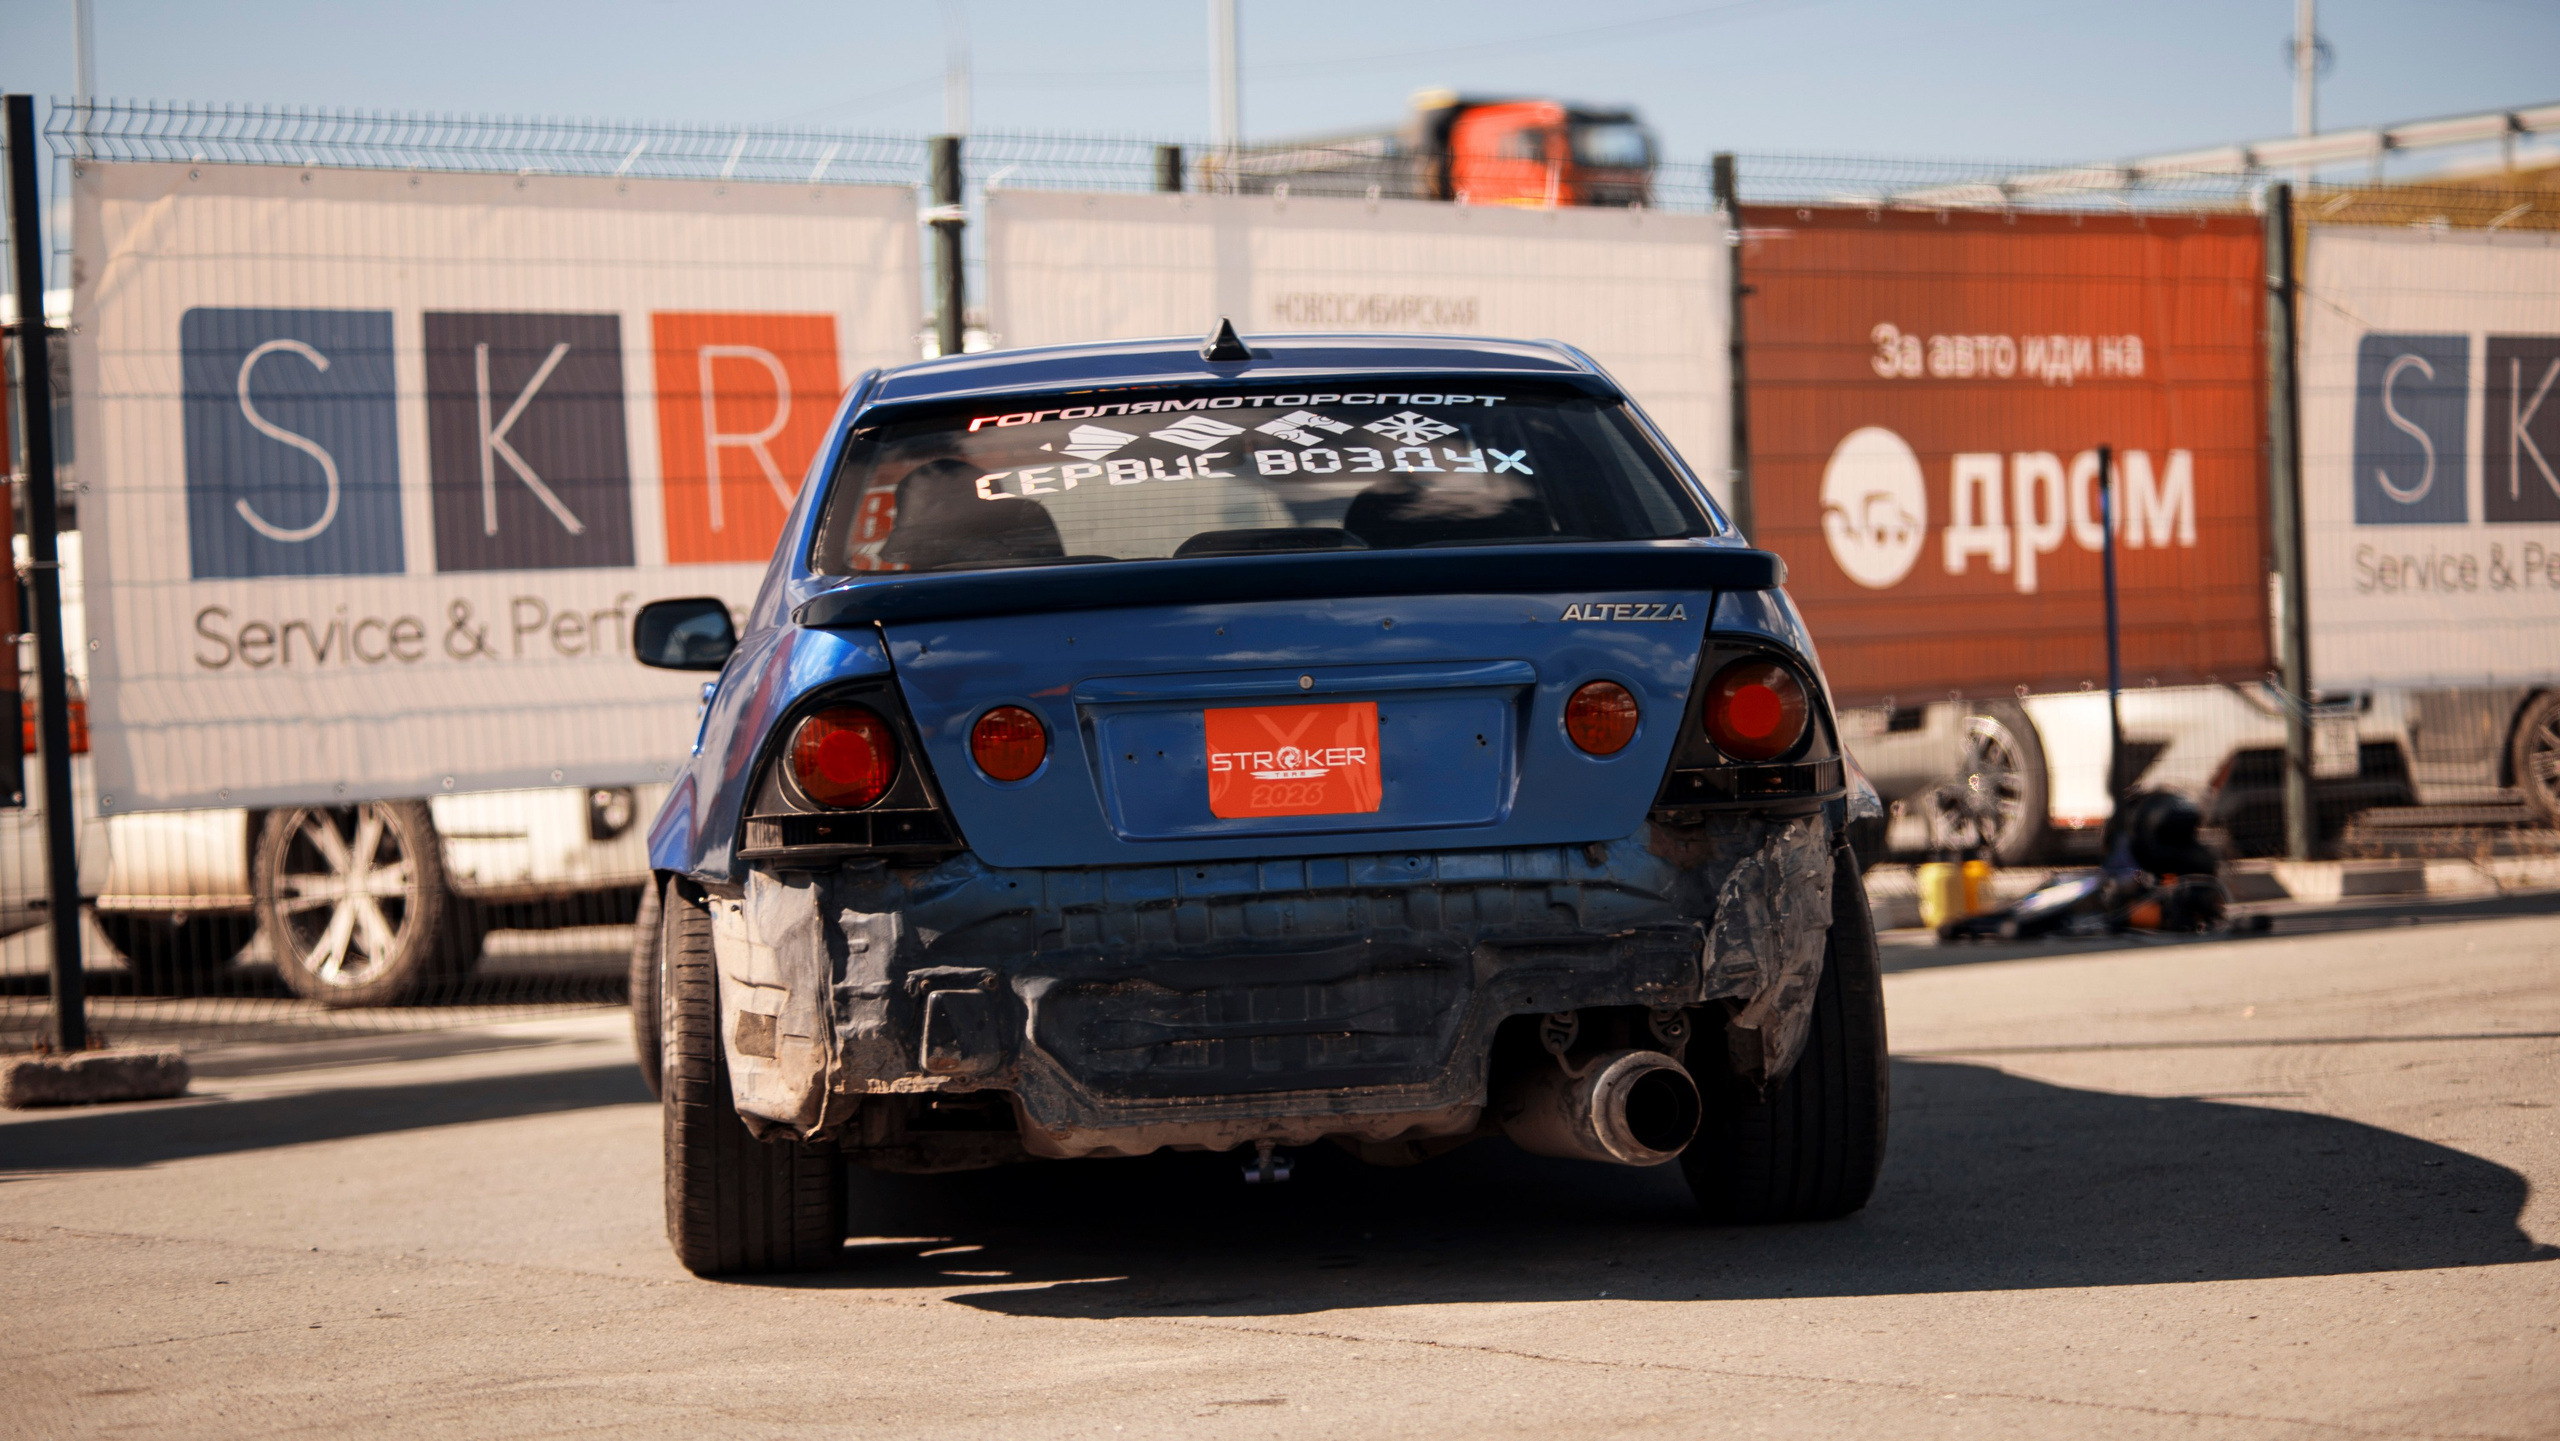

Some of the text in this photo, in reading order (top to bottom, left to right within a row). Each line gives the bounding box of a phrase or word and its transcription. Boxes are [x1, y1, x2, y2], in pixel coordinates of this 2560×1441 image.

[1870, 323, 2145, 386] За авто иди на
[968, 393, 1506, 433] ГОГОЛЯМОТОРСПОРТ
[1254, 447, 1534, 476] ВОЗДУХ
[2355, 543, 2479, 593] Service
[2489, 541, 2518, 592] &
[194, 590, 638, 669] Service & Perf
[1560, 603, 1688, 621] ALTEZZA
[1250, 782, 1327, 808] 2026
